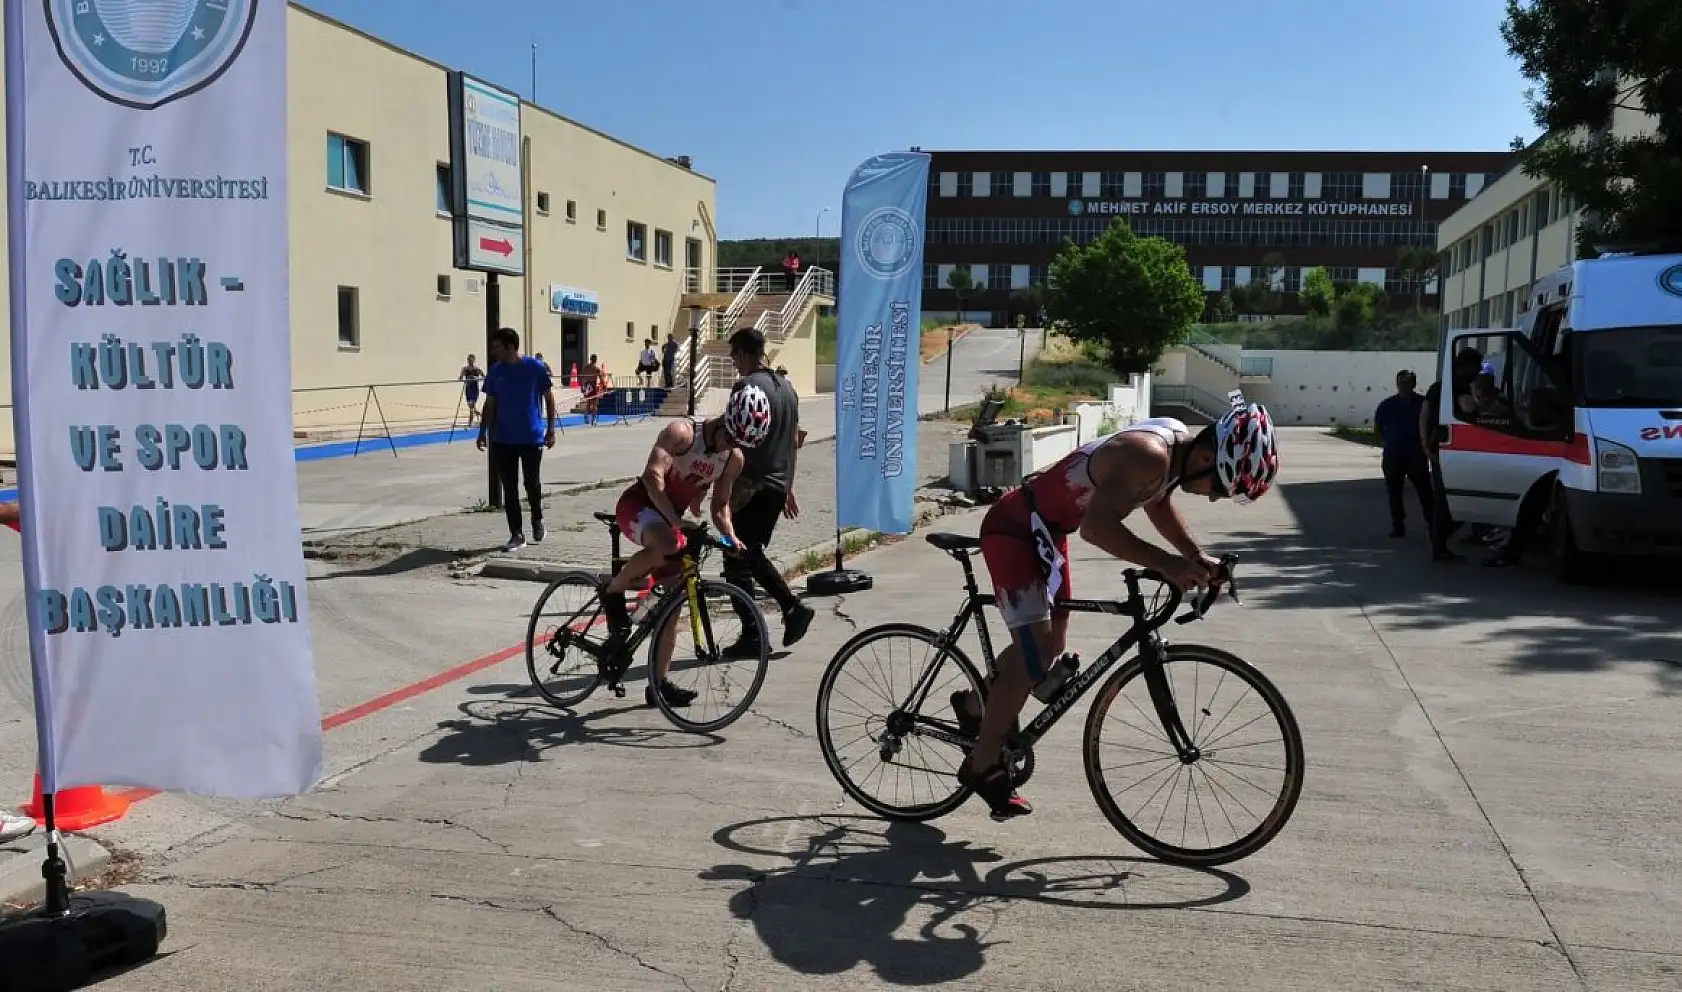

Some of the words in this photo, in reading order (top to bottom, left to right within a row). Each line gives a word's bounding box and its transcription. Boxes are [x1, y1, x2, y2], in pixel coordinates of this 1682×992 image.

[130, 57, 169, 73] 1992
[128, 145, 157, 167] T.C.
[24, 176, 127, 200] BALIKESİR
[128, 173, 269, 200] ÜNİVERSİTESİ
[1087, 201, 1149, 215] MEHMET
[1153, 200, 1188, 214] AKİF
[1191, 202, 1239, 215] ERSOY
[1243, 202, 1304, 215] MERKEZ
[1307, 200, 1413, 216] KÜTÜPHANESİ
[54, 247, 209, 307] SAĞLIK
[69, 333, 235, 390] KÜLTÜR
[881, 300, 910, 480] ÜNİVERSİTESİ
[859, 321, 882, 460] BALIKESİR
[68, 424, 124, 472] VE
[134, 423, 249, 471] SPOR
[97, 495, 228, 552] DAİRE
[39, 573, 299, 638] BAŞKANLIĞI
[1033, 654, 1111, 731] cannondale
